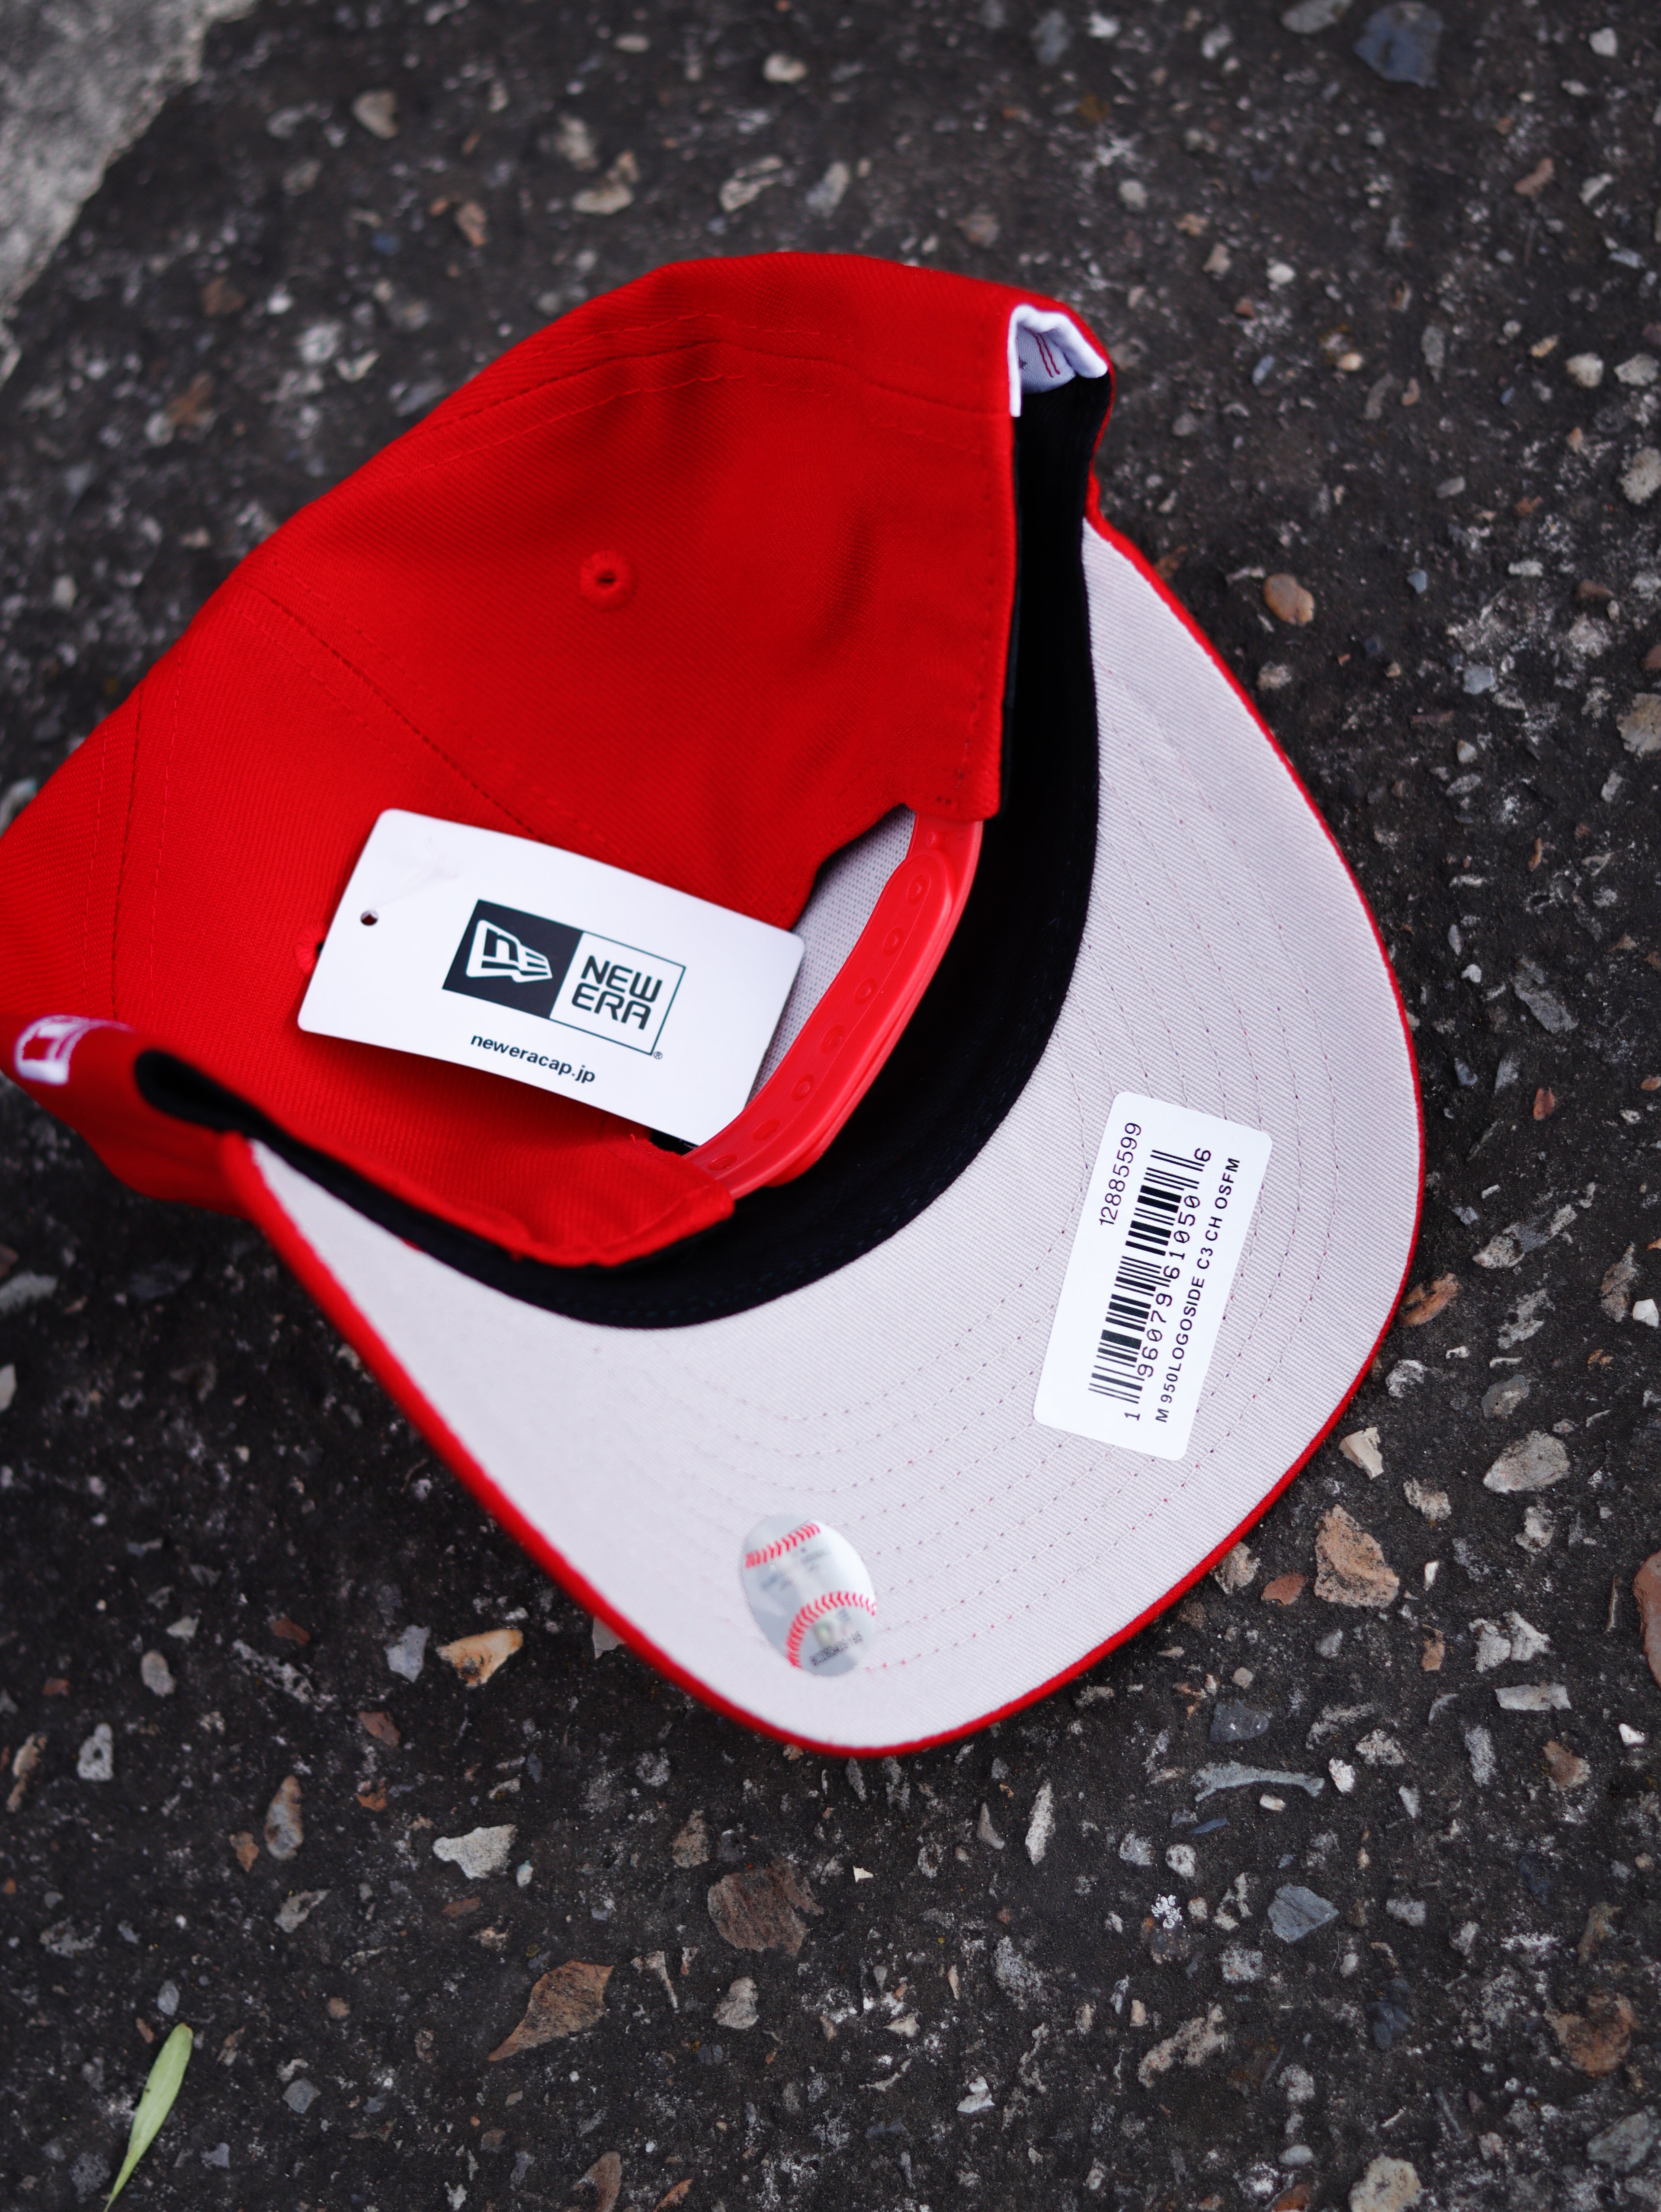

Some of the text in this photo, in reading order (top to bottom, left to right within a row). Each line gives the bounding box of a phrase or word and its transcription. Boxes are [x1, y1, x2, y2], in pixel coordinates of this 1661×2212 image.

[571, 983, 652, 1031] ERA
[581, 955, 663, 1003] NEW
[470, 1035, 596, 1084] neweracap.jp
[1099, 1123, 1142, 1225] 12885599
[1137, 1293, 1173, 1377] 96079
[1163, 1195, 1201, 1280] 61050
[1155, 1408, 1169, 1423] M
[1197, 1247, 1213, 1270] C3
[1205, 1216, 1223, 1242] CH
[1215, 1157, 1241, 1210] OSFM
